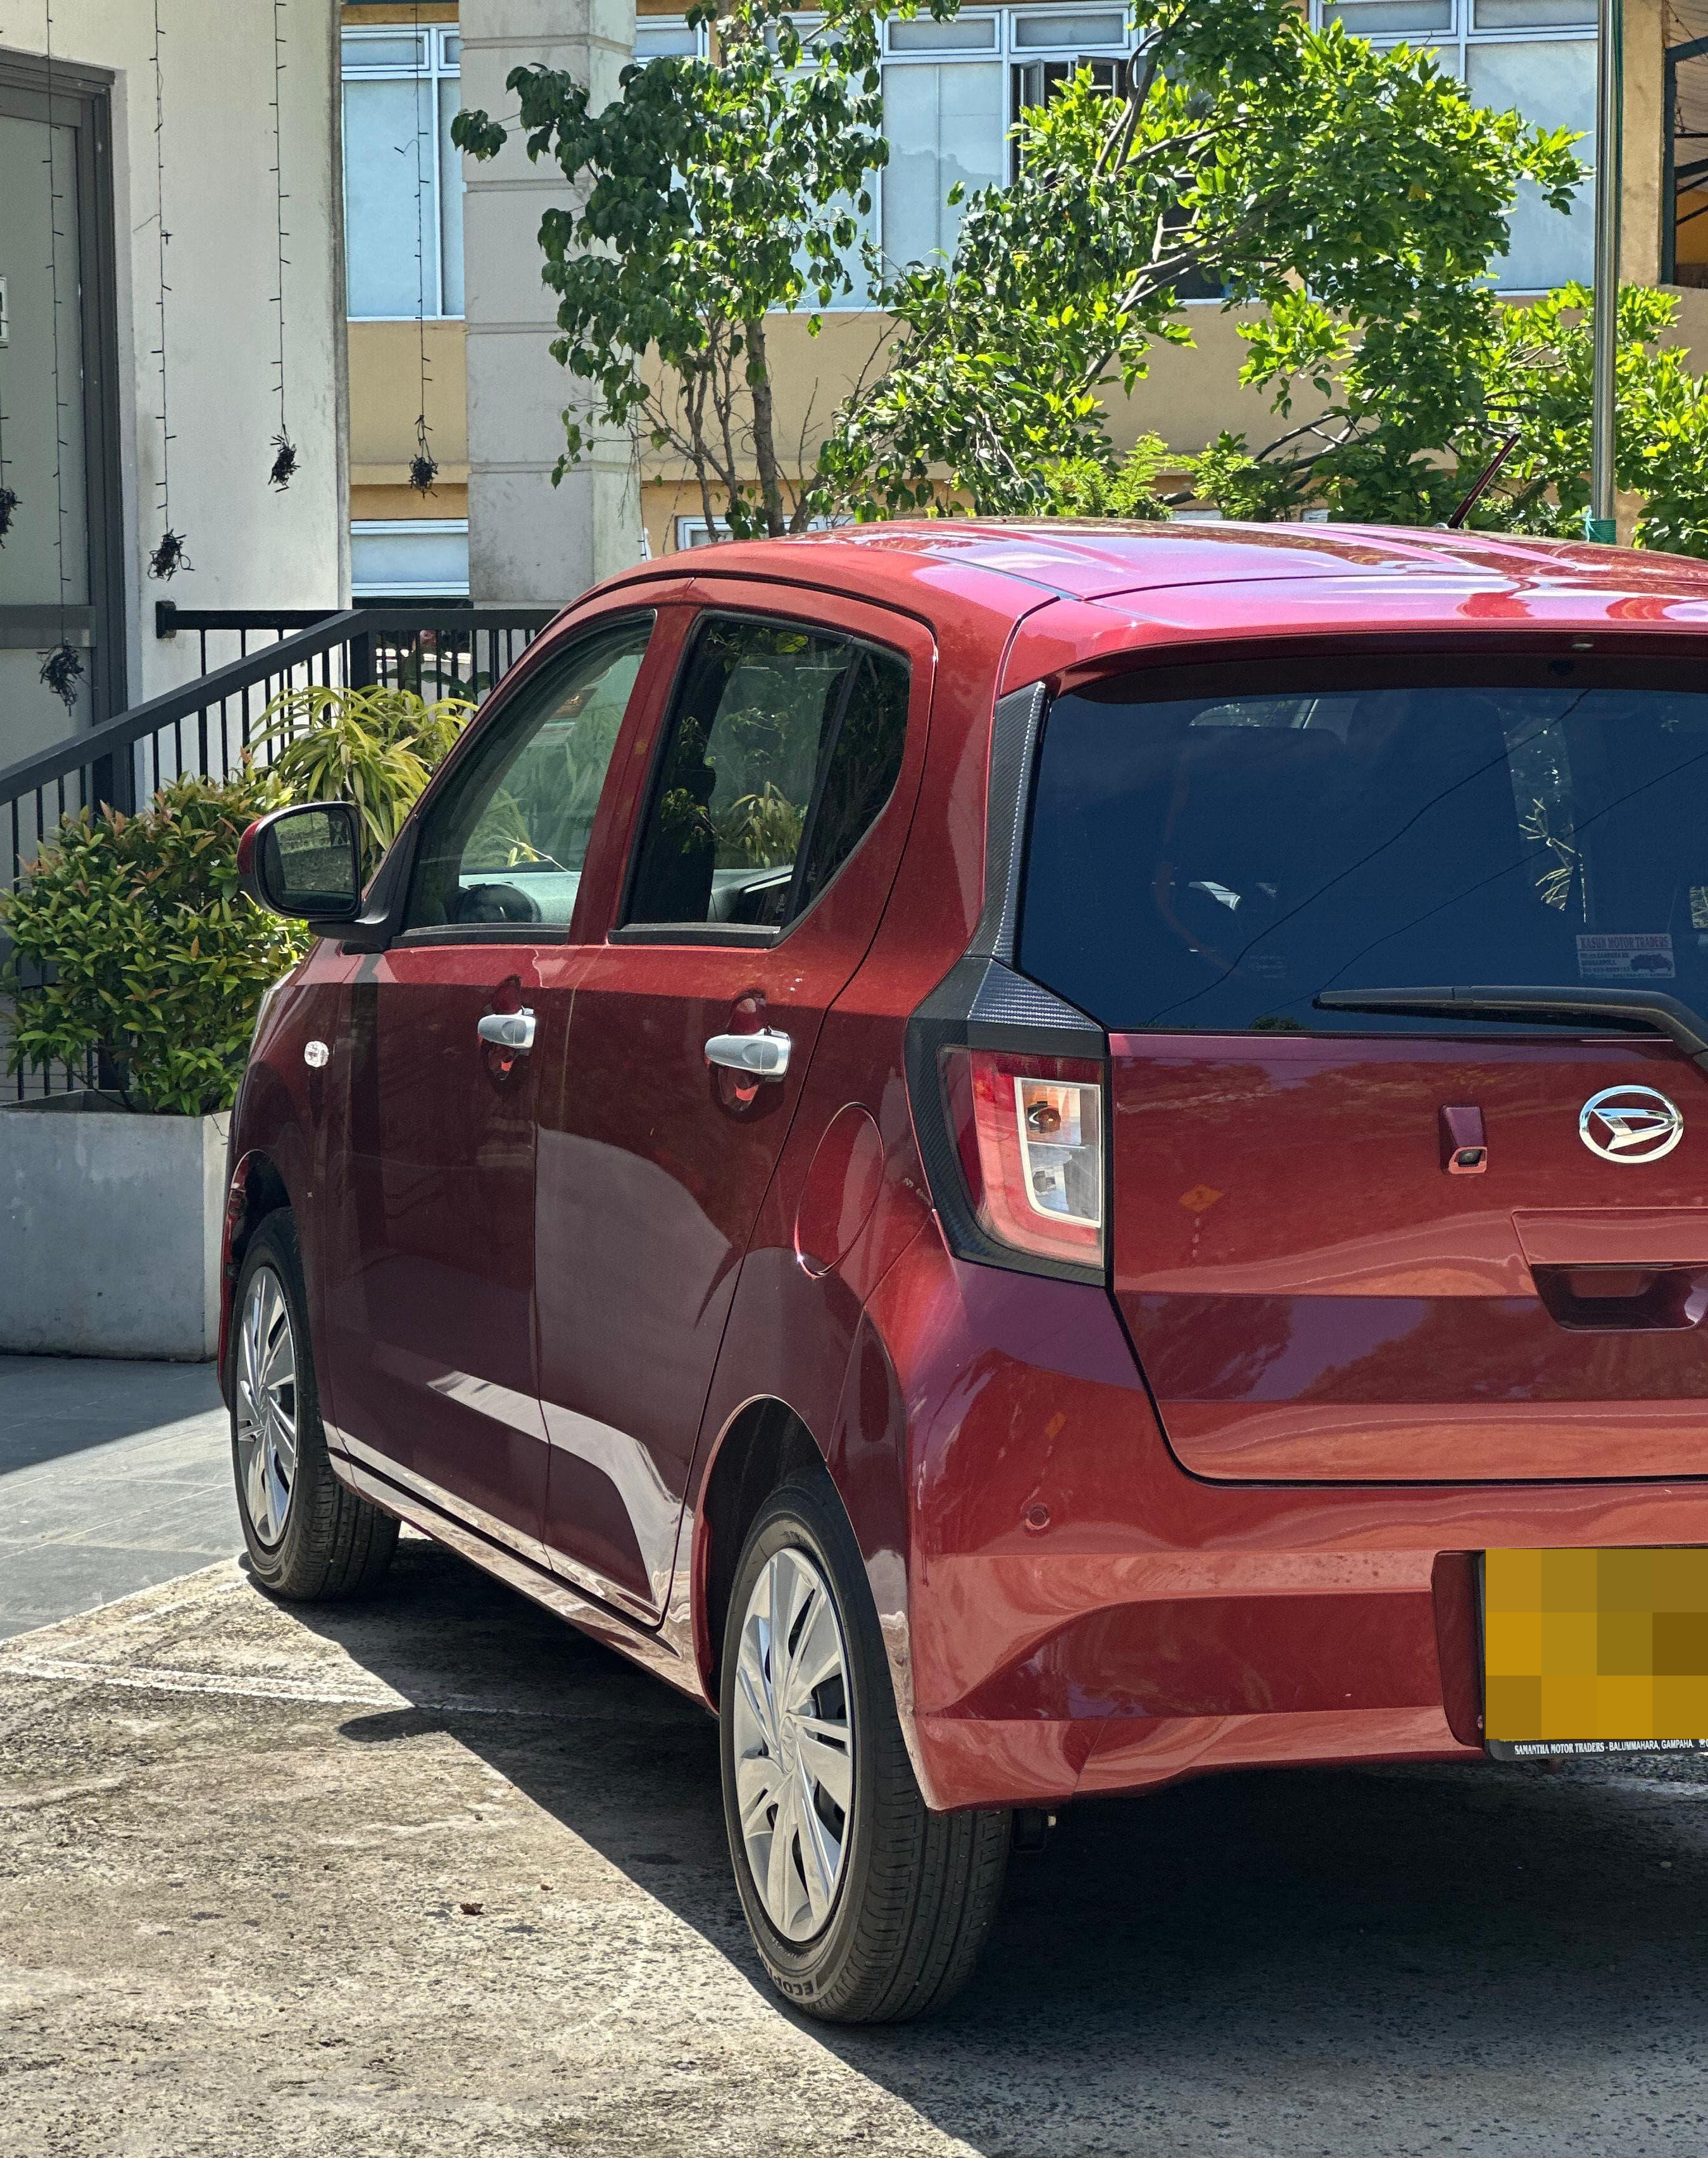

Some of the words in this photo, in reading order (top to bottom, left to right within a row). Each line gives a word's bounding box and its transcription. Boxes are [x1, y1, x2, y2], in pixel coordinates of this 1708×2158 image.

[1608, 936, 1634, 948] MOTOR
[1635, 936, 1669, 948] TRADERS
[1514, 1745, 1550, 1755] SAMANTHA
[1550, 1743, 1574, 1754] MOTOR
[1575, 1742, 1605, 1753] TRADERS
